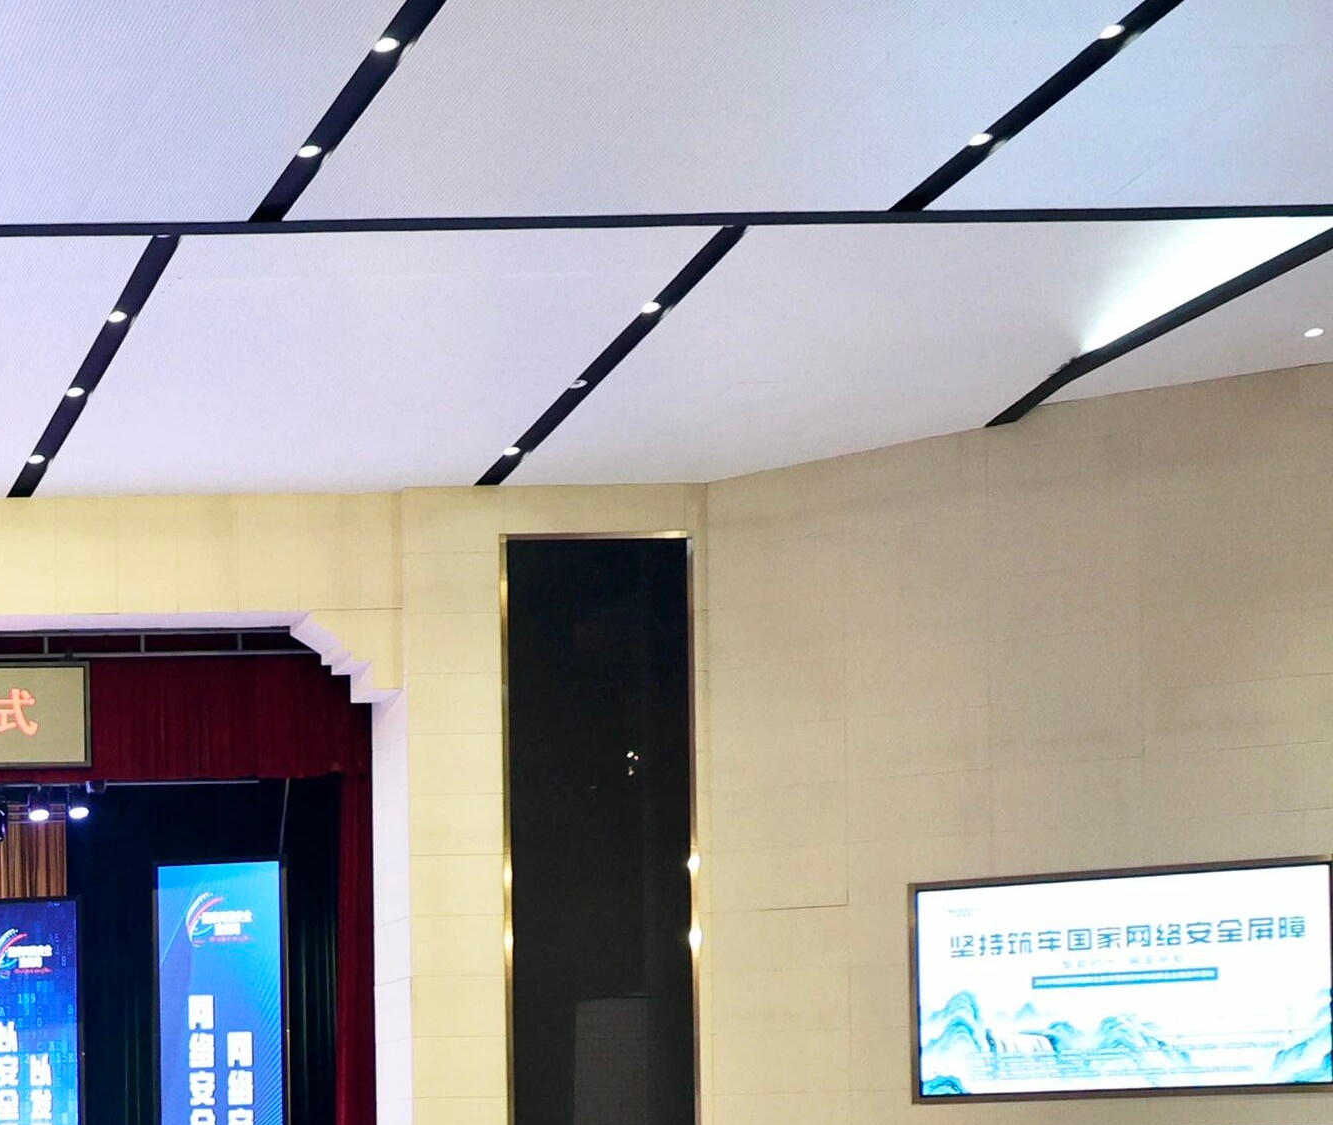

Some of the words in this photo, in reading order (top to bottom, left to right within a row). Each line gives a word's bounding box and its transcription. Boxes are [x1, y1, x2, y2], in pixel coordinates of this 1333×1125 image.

[950, 915, 1306, 958] 坚持筑牢国家网络安全屏障
